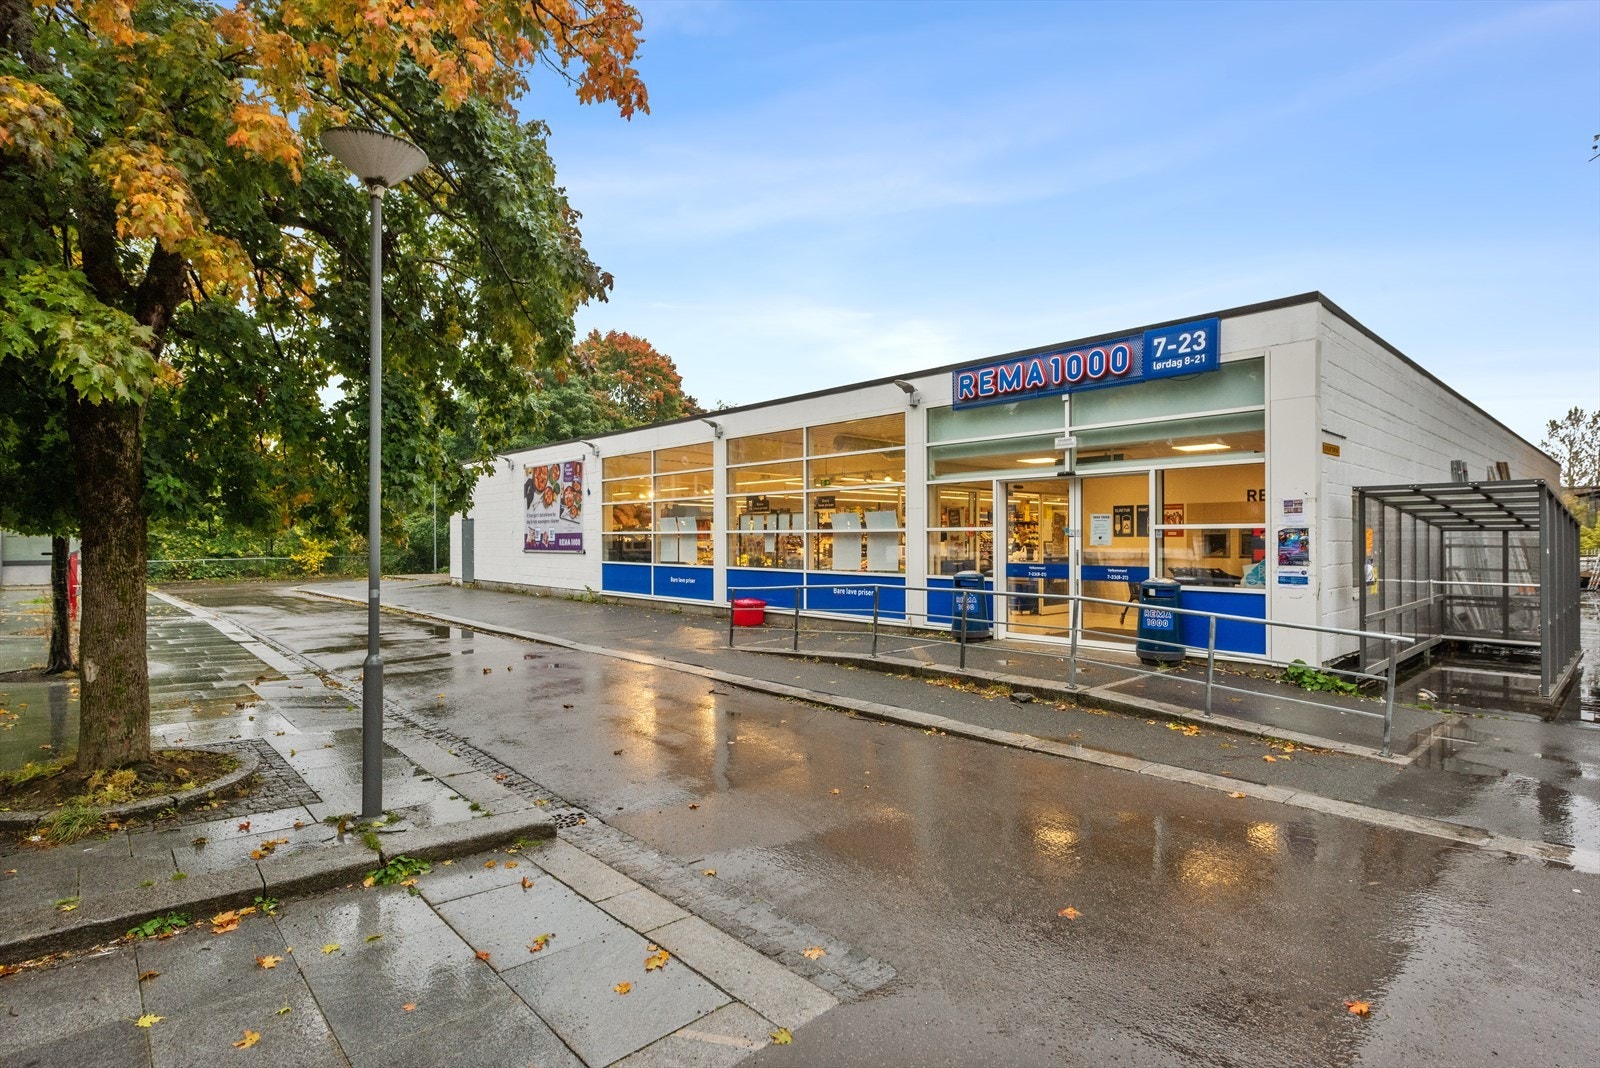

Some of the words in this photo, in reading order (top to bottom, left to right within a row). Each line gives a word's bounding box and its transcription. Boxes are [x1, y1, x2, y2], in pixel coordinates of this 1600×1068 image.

[1153, 330, 1206, 358] 7-23
[1184, 354, 1206, 365] 8-21
[958, 358, 1046, 400] REMA
[1050, 343, 1132, 385] 1000
[833, 587, 845, 595] Bare
[845, 587, 857, 596] lave
[858, 588, 874, 597] priser
[1143, 608, 1172, 619] REMA
[1146, 618, 1169, 628] 1000
